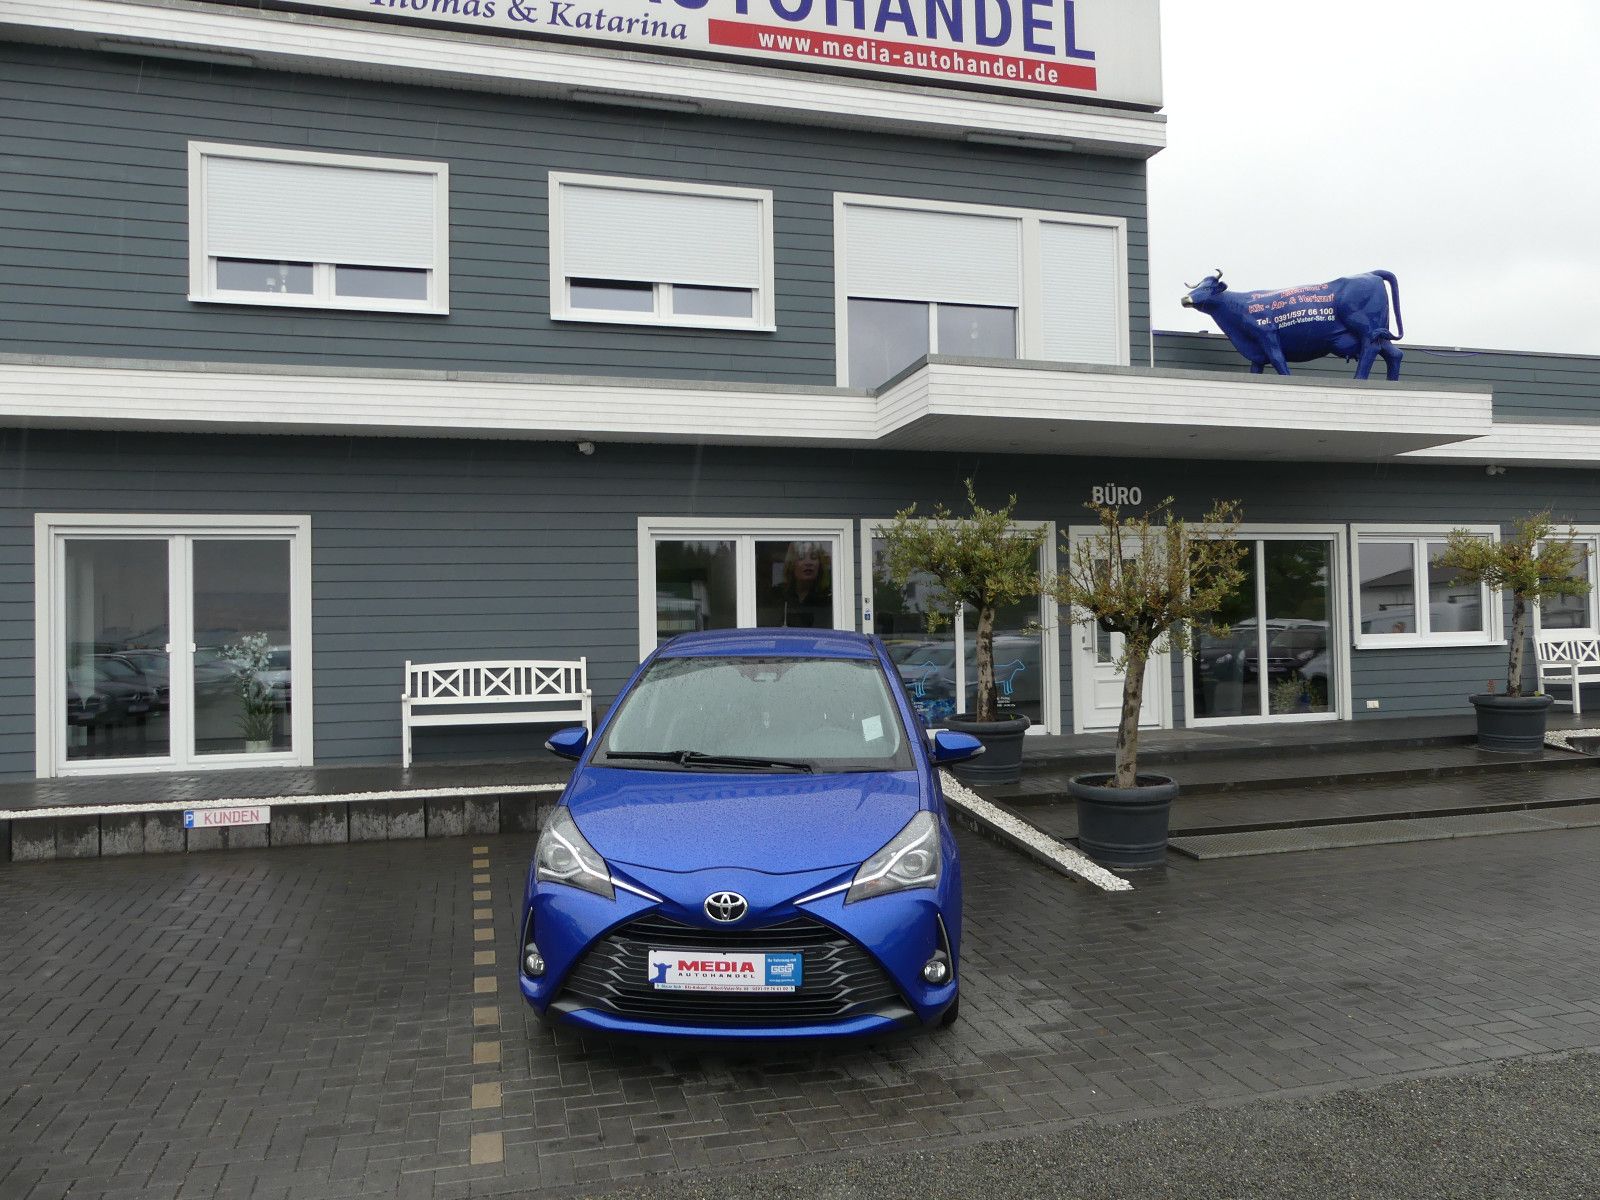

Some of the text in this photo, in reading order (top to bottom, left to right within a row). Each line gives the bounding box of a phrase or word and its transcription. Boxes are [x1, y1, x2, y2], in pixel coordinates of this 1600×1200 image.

[507, 0, 538, 24] &
[546, 1, 688, 41] Katarina
[758, 32, 1059, 84] www.media-autohandel.de
[1256, 307, 1334, 326] Tel. 0391/597 66 100
[1092, 483, 1142, 505] BÜRO
[186, 809, 260, 825] P KUNDEN
[678, 960, 755, 973] MEDIA
